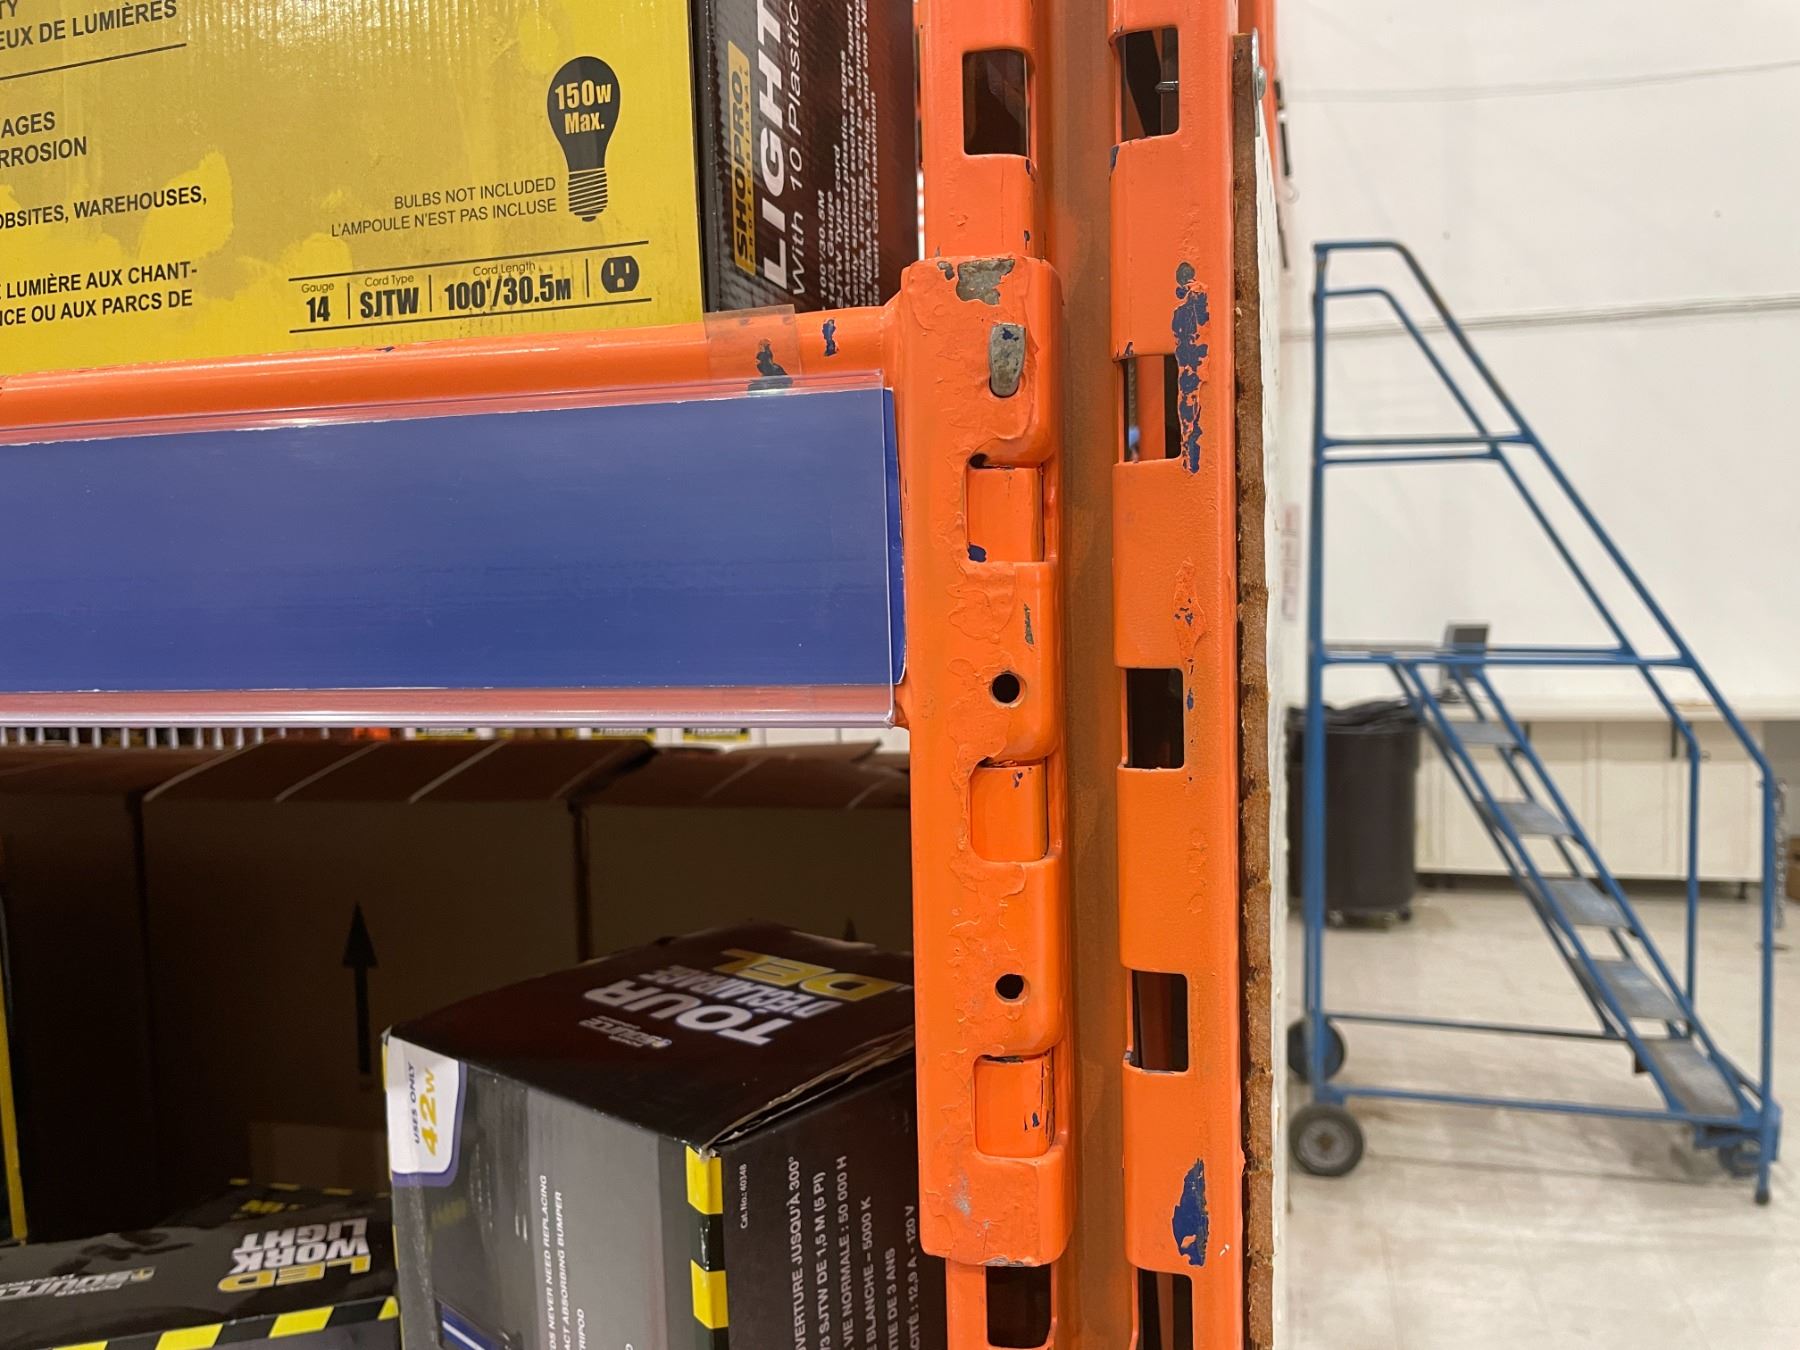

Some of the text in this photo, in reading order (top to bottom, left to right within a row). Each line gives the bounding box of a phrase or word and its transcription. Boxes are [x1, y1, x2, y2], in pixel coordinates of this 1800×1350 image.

[39, 19, 66, 43] DE
[73, 0, 178, 37] LUMIÈRES
[840, 49, 848, 110] cages
[1, 111, 55, 138] AGES
[564, 112, 605, 134] Max.
[757, 0, 788, 290] LIGHT
[788, 0, 806, 295] With 10 Plastic
[841, 115, 850, 184] plastic
[731, 70, 748, 260] SHOPRO
[743, 69, 754, 264] PROFESSIONAL
[833, 144, 842, 193] cord
[73, 185, 207, 219] WAREHOUSES,
[394, 176, 556, 210] BULBS NOT INCLUDED
[850, 176, 859, 249] spaced
[331, 198, 557, 238] L'AMPOULE N'EST PAS INCLUSE
[827, 190, 836, 258] Gauge
[835, 198, 843, 245] Type
[842, 186, 851, 299] Assembled
[6, 273, 81, 299] LUMIÈRE
[86, 269, 122, 290] AUX
[128, 261, 197, 283] CHANT-
[364, 273, 414, 287] Cord Type
[473, 260, 536, 277] Cord Length
[0, 289, 193, 327] CE OU AUX PARCS DE
[301, 282, 335, 295] Gauge
[360, 287, 419, 318] SJTW
[306, 296, 331, 322] 14
[712, 947, 900, 1002] DEL
[583, 979, 793, 1046] TOUR
[407, 1061, 420, 1144] USES ONLY
[837, 1155, 847, 1169] H
[813, 1171, 826, 1194] PI)
[838, 1172, 848, 1201] 000
[861, 1195, 872, 1209] K
[554, 1190, 565, 1249] BUMPER
[814, 1196, 827, 1212] (5
[815, 1214, 826, 1231] M
[839, 1203, 849, 1223] 50
[905, 1204, 915, 1215] V
[232, 1217, 369, 1256] LIGHT
[787, 1192, 804, 1265] JUSQU'À
[815, 1233, 828, 1257] 1,5
[862, 1211, 873, 1250] 5000
[906, 1217, 917, 1244] 120
[217, 1254, 371, 1293] LED
[227, 1235, 370, 1275] WORK
[540, 1174, 557, 1350] DS NEVER NEED REPLACING
[817, 1259, 828, 1283] DE
[885, 1247, 896, 1280] ANS
[907, 1256, 918, 1268] A
[557, 1249, 570, 1325] ABSORBING
[839, 1234, 853, 1317] NORMALE
[886, 1283, 897, 1295] 3
[818, 1287, 830, 1334] SJTW
[864, 1264, 877, 1343] BLANCHE
[887, 1296, 898, 1319] DE
[576, 1308, 587, 1350] RIPOD
[842, 1318, 854, 1347] VIE
